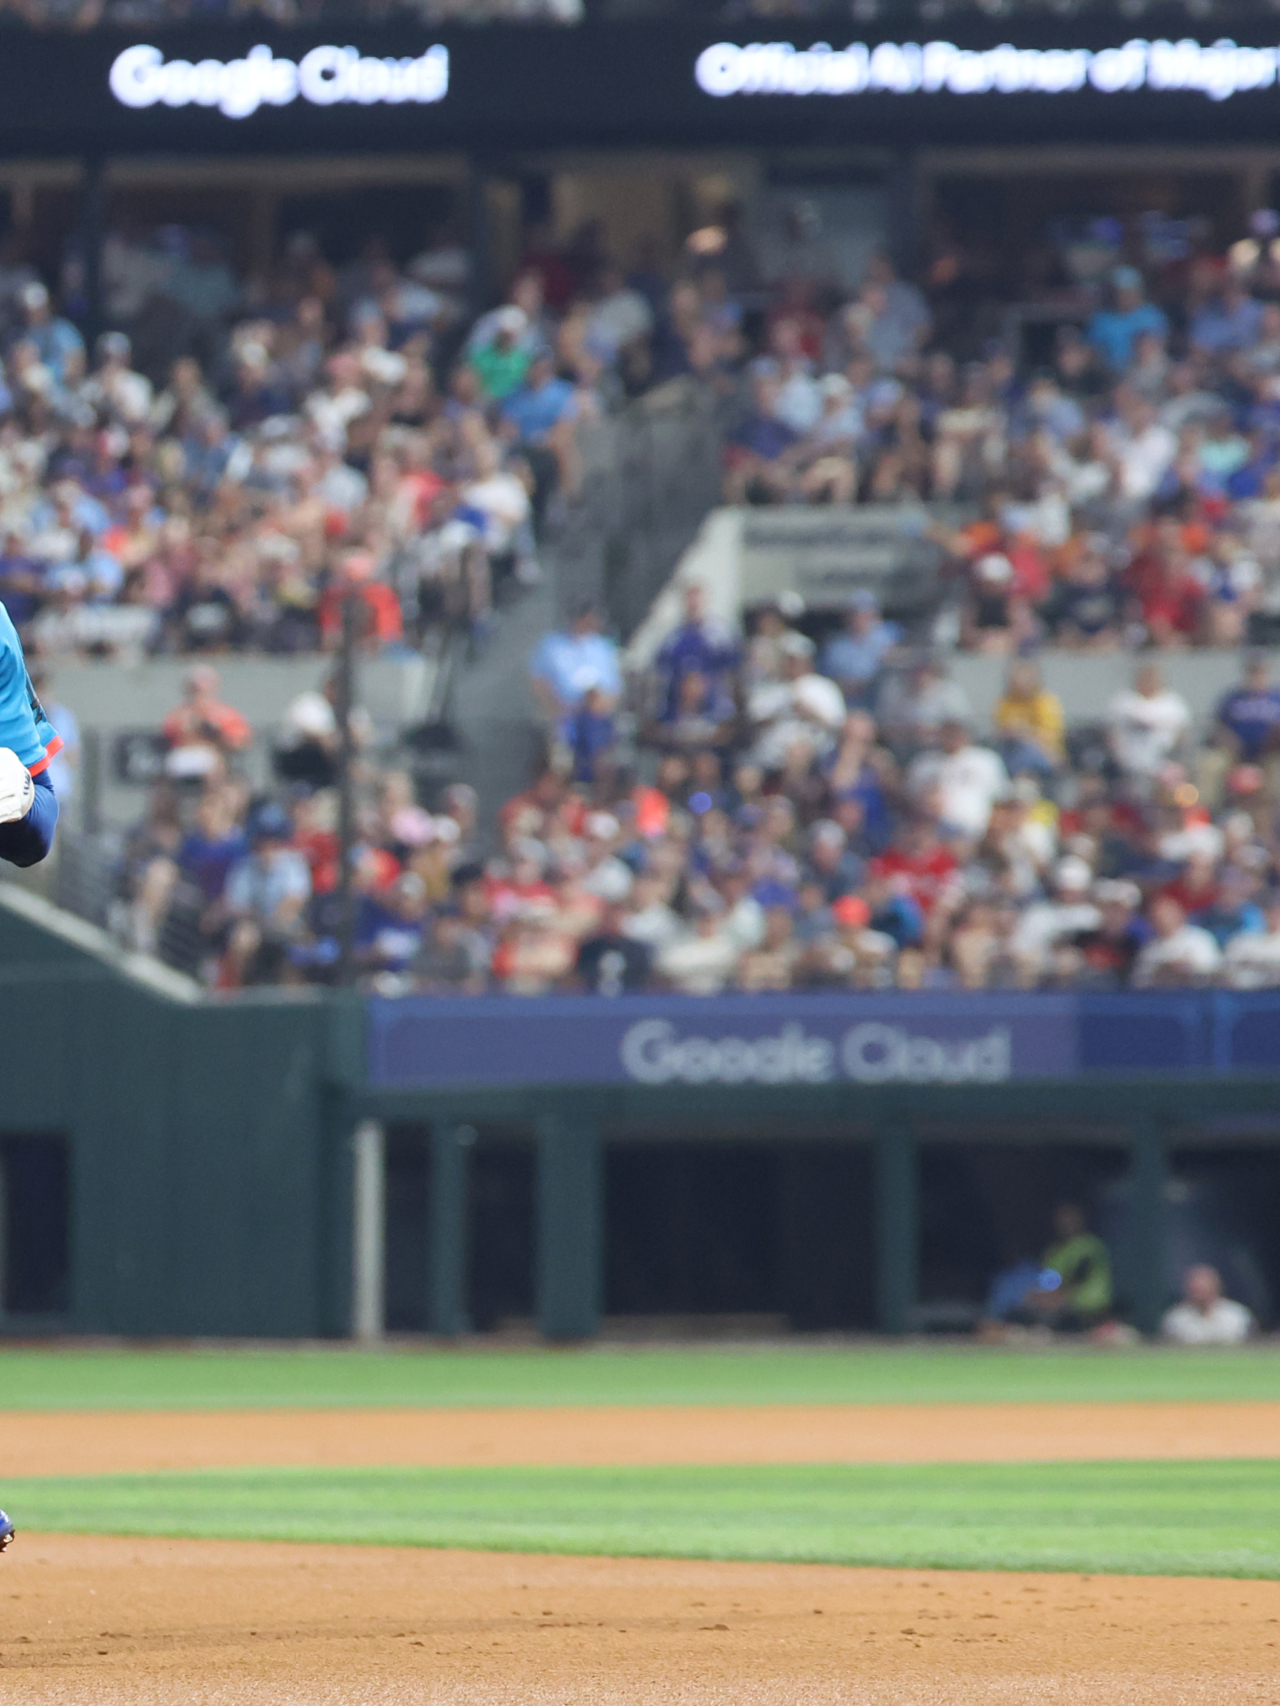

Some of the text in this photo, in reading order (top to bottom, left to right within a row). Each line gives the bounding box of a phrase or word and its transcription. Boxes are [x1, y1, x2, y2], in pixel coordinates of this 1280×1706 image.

[109, 44, 449, 119] Google Cloud
[621, 1017, 1013, 1085] Google Cloud
